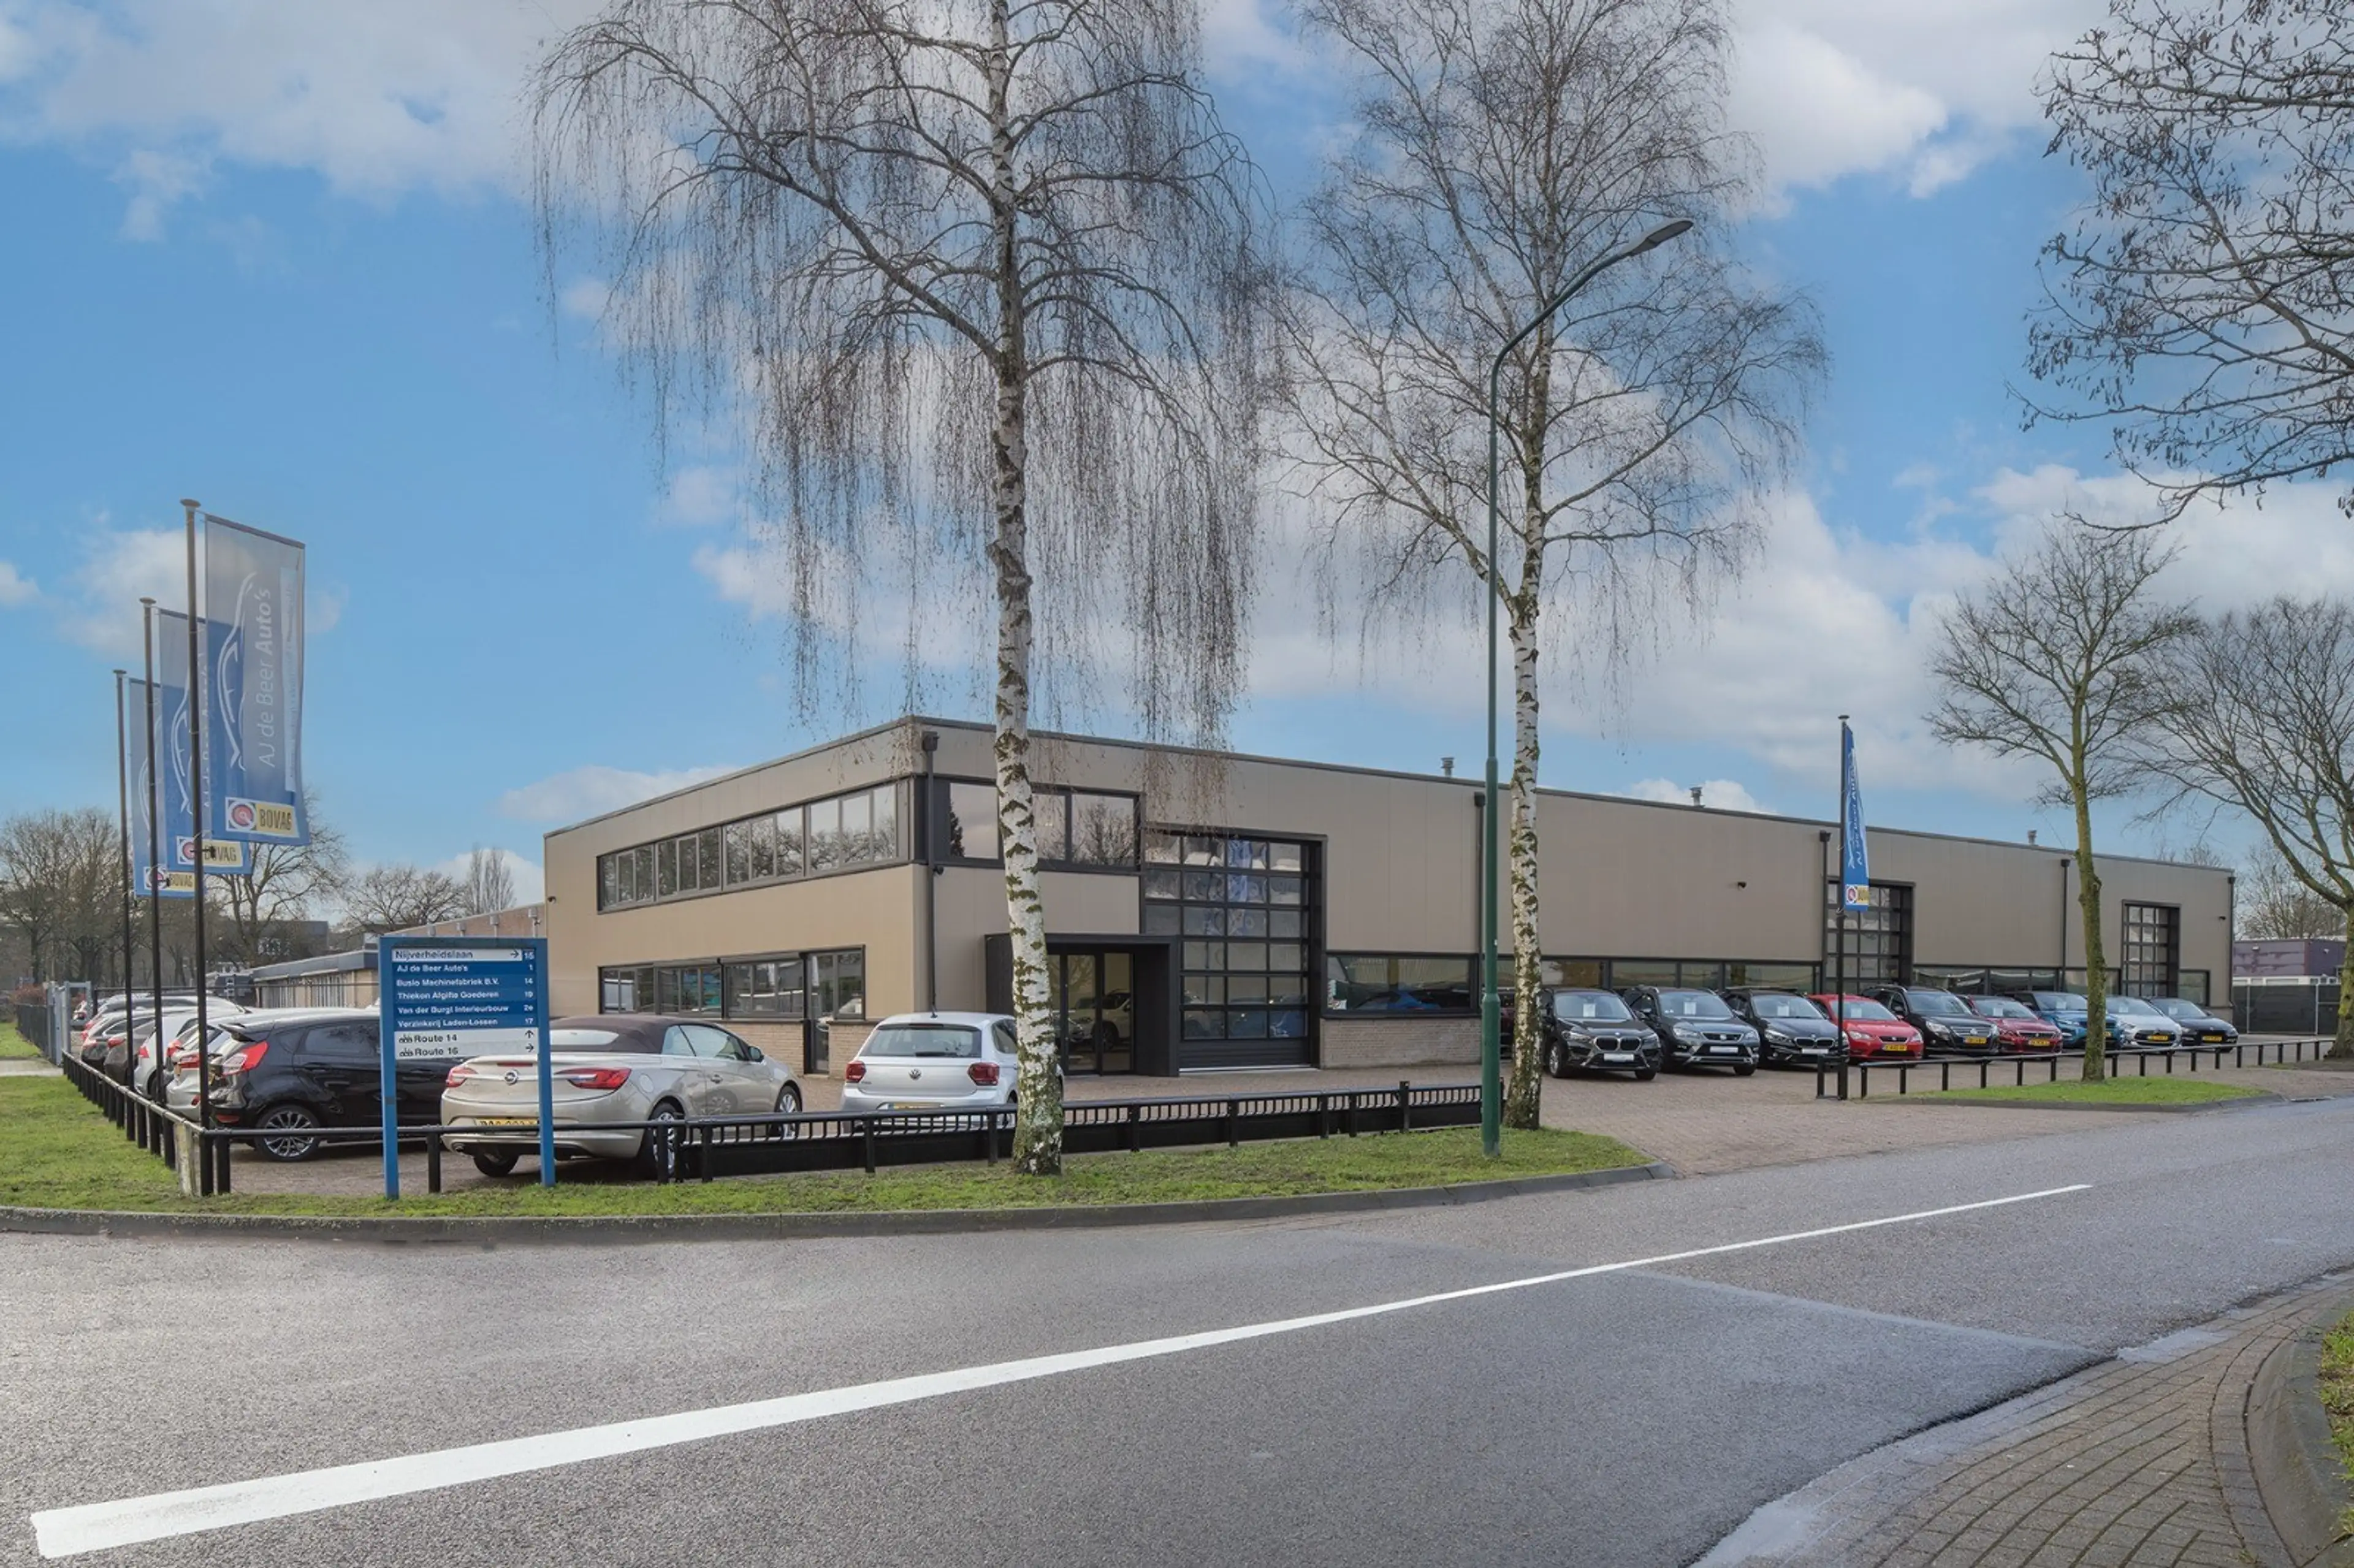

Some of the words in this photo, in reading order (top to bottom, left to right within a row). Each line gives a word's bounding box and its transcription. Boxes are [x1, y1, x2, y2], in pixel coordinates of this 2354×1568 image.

[253, 587, 273, 656] Auto's
[255, 661, 274, 706] Beer
[257, 711, 275, 737] de
[257, 742, 276, 768] AJ
[259, 809, 292, 831] BOVAG
[204, 845, 237, 862] BVAG
[395, 950, 473, 961] Nijverheidslaan
[443, 964, 469, 972] Auto's
[422, 978, 483, 986] Machinefabriek
[454, 1005, 509, 1013] Interieurbouw
[414, 1034, 444, 1043] Route
[414, 1048, 444, 1056] Route
